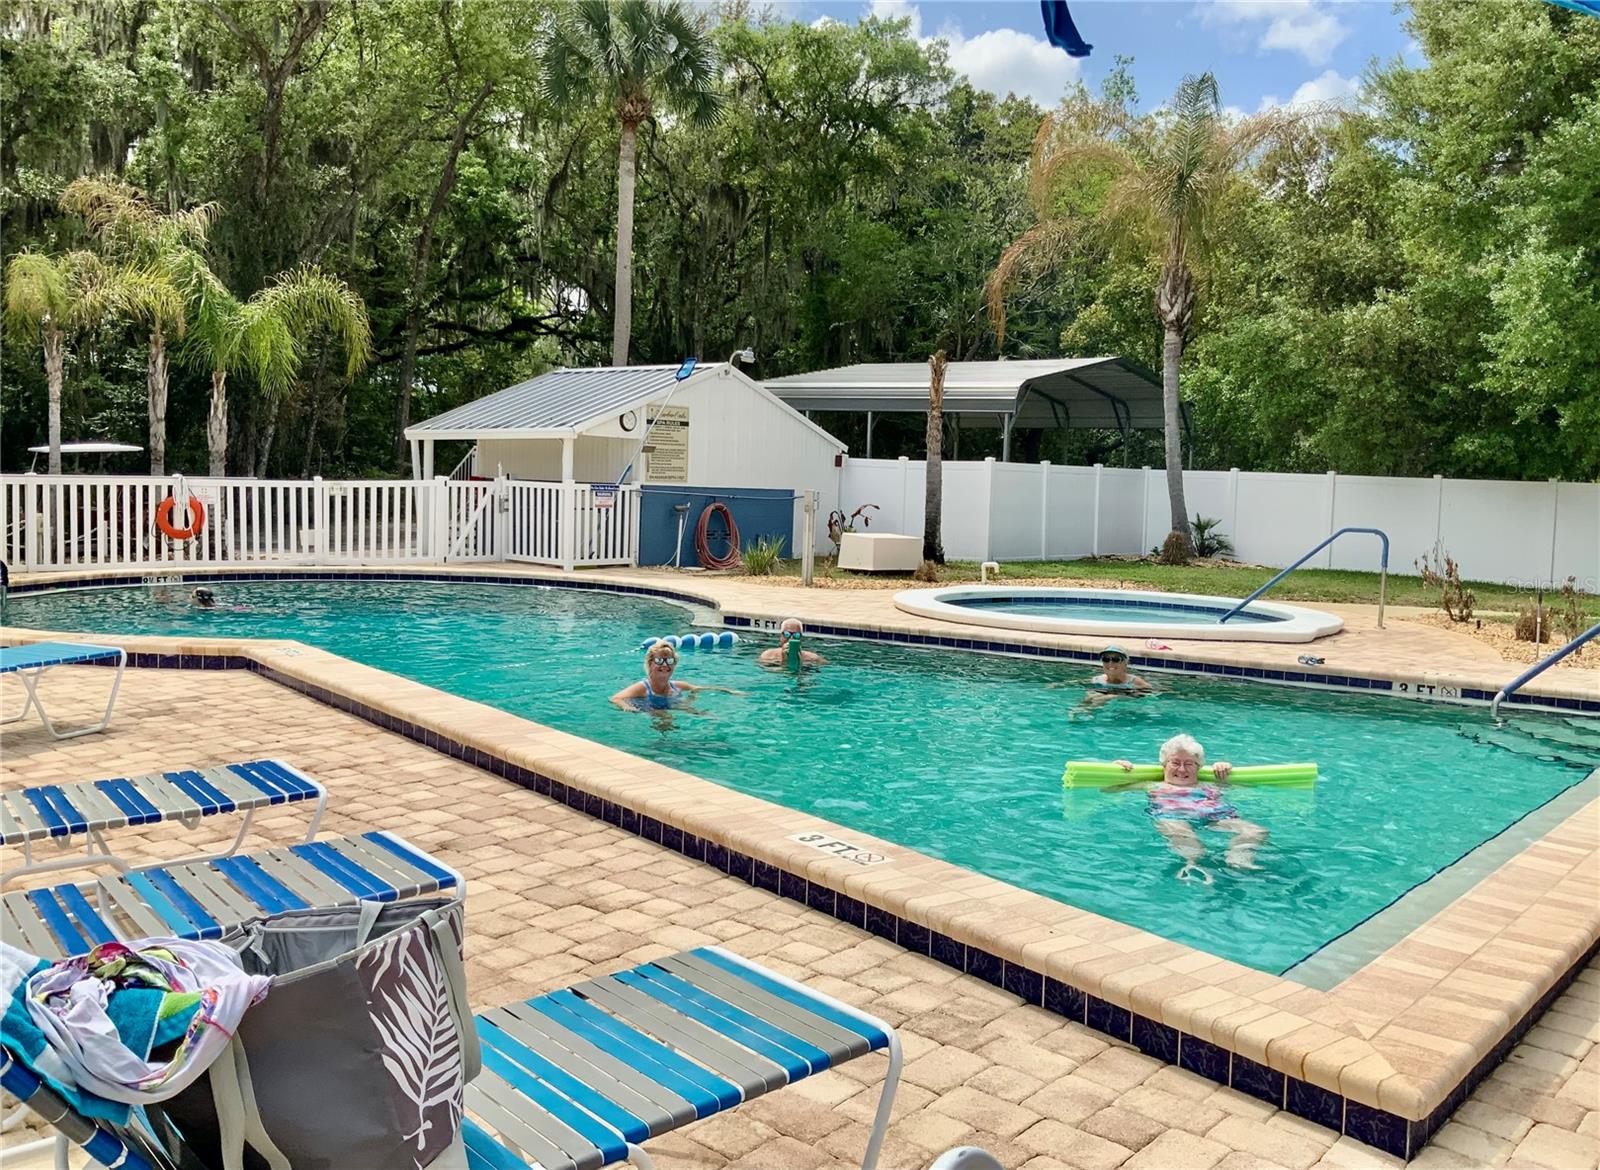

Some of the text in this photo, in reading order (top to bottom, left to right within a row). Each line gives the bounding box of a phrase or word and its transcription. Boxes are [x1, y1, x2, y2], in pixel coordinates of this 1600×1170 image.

[754, 619, 777, 630] 5 FT
[1417, 684, 1436, 695] FT
[799, 834, 859, 854] 3 FT
